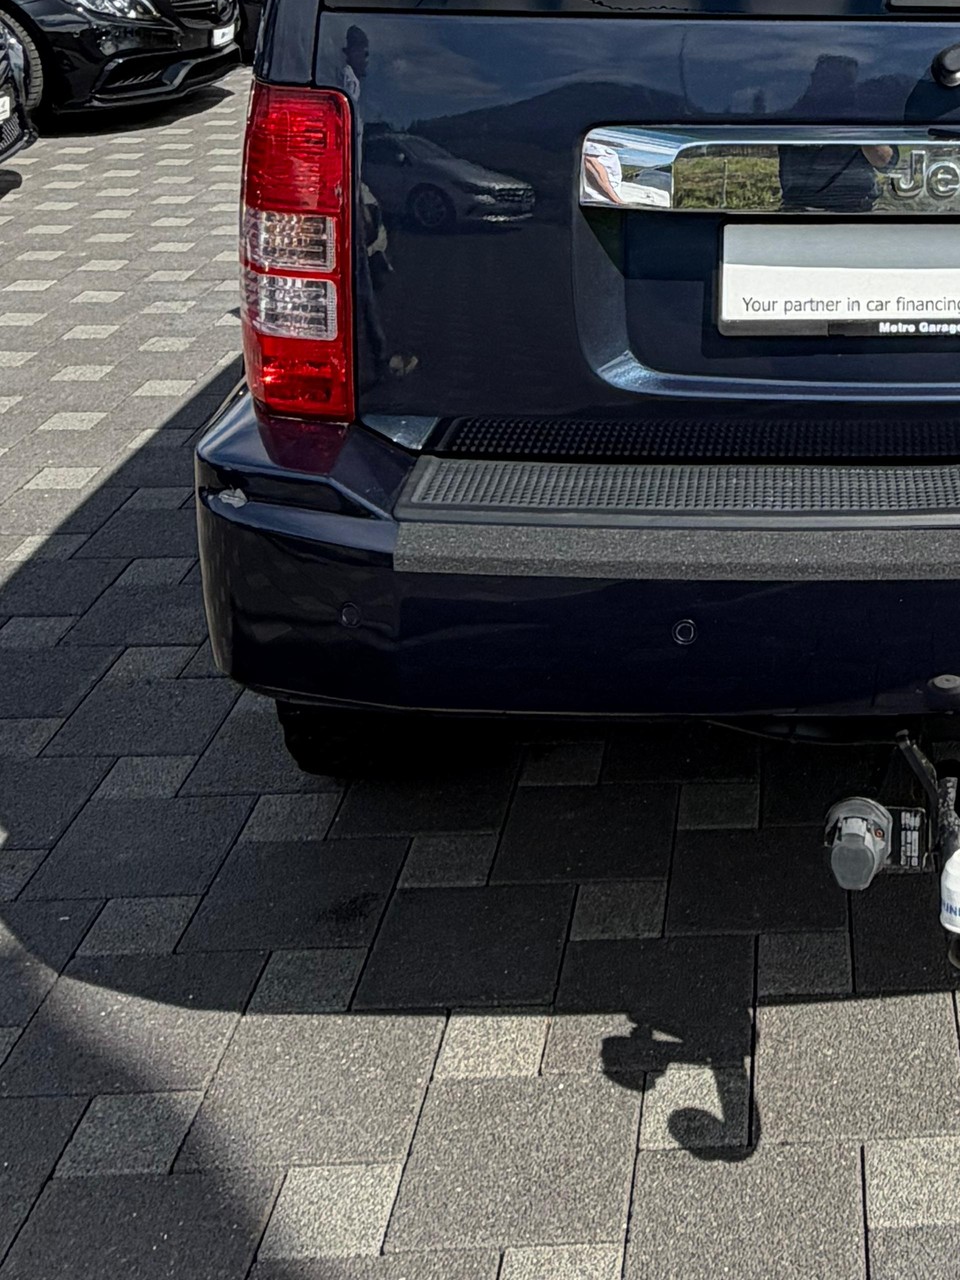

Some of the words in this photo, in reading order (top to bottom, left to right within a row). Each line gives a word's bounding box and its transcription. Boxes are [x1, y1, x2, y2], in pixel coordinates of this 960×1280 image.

[742, 297, 778, 312] Your
[784, 297, 841, 315] partner
[847, 297, 860, 312] in
[866, 298, 891, 312] car
[879, 322, 916, 333] Metro
